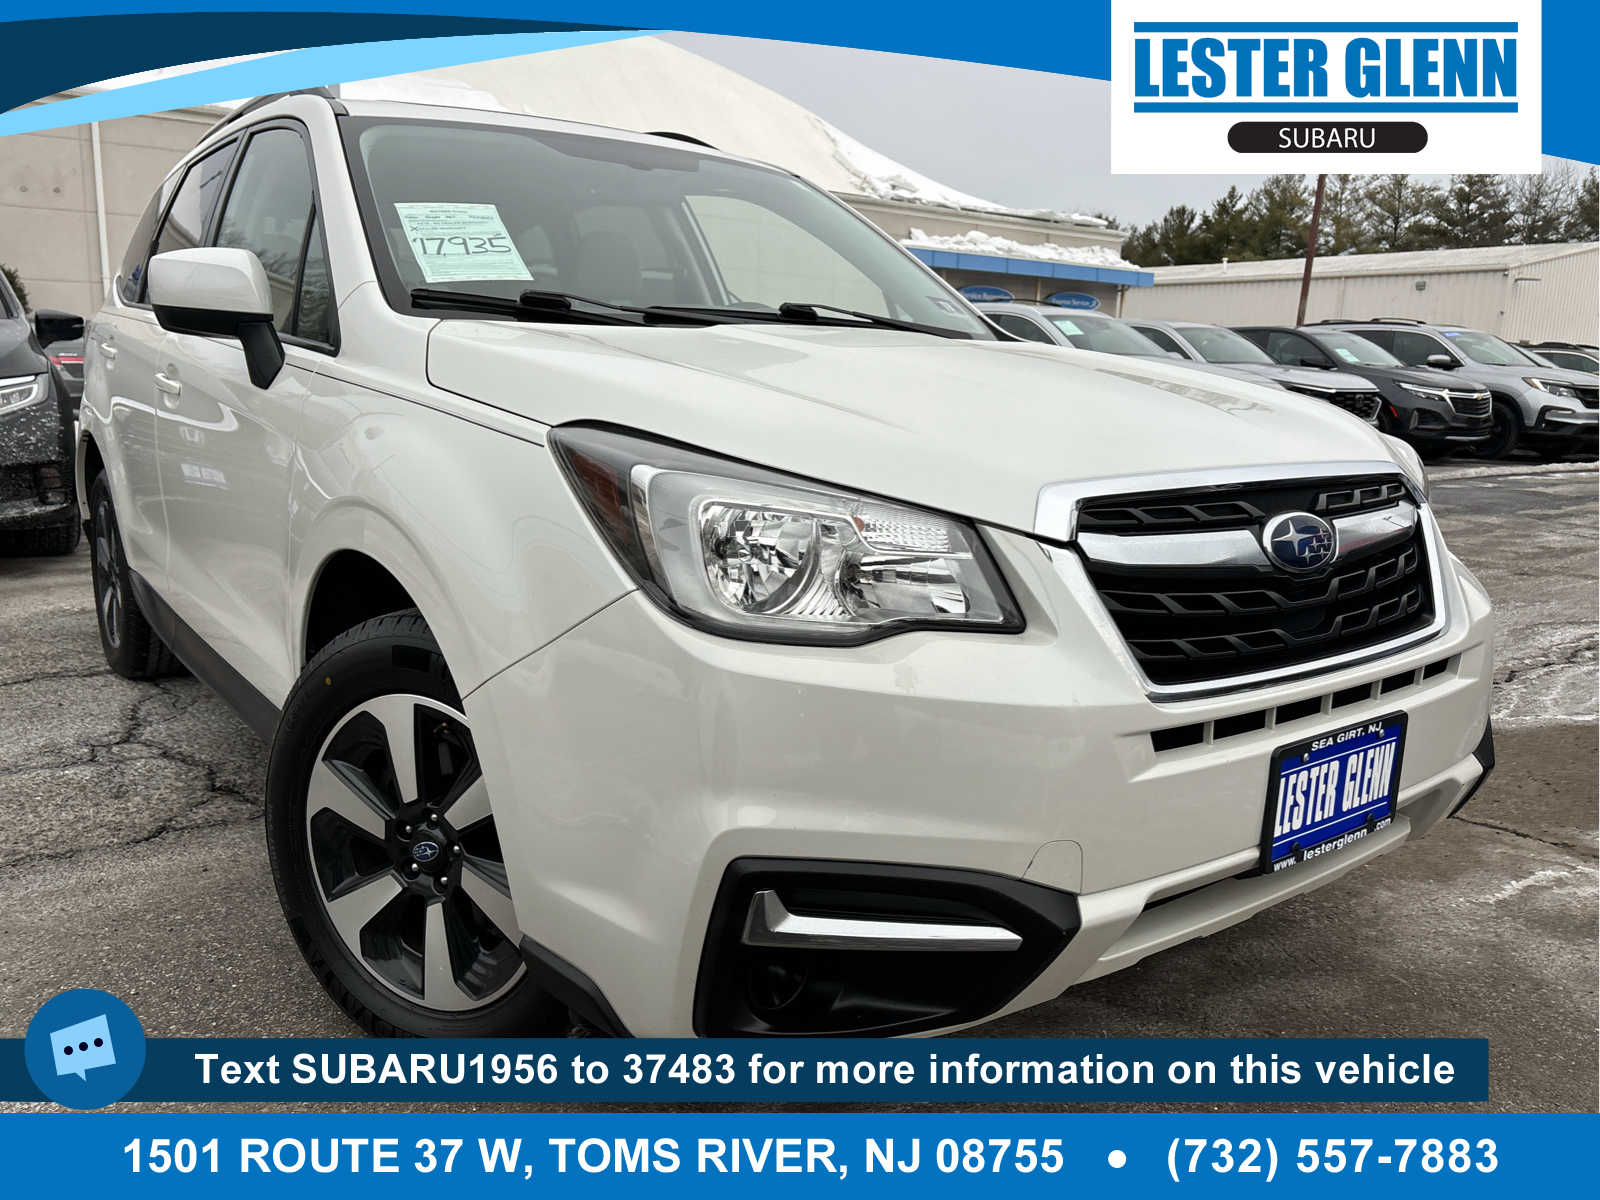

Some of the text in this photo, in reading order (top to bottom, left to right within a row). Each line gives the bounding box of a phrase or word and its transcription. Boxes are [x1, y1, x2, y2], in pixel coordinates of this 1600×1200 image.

[1311, 737, 1334, 752] SEA
[1273, 742, 1396, 838] LESTER GLENN
[1303, 828, 1368, 861] lesterglenn
